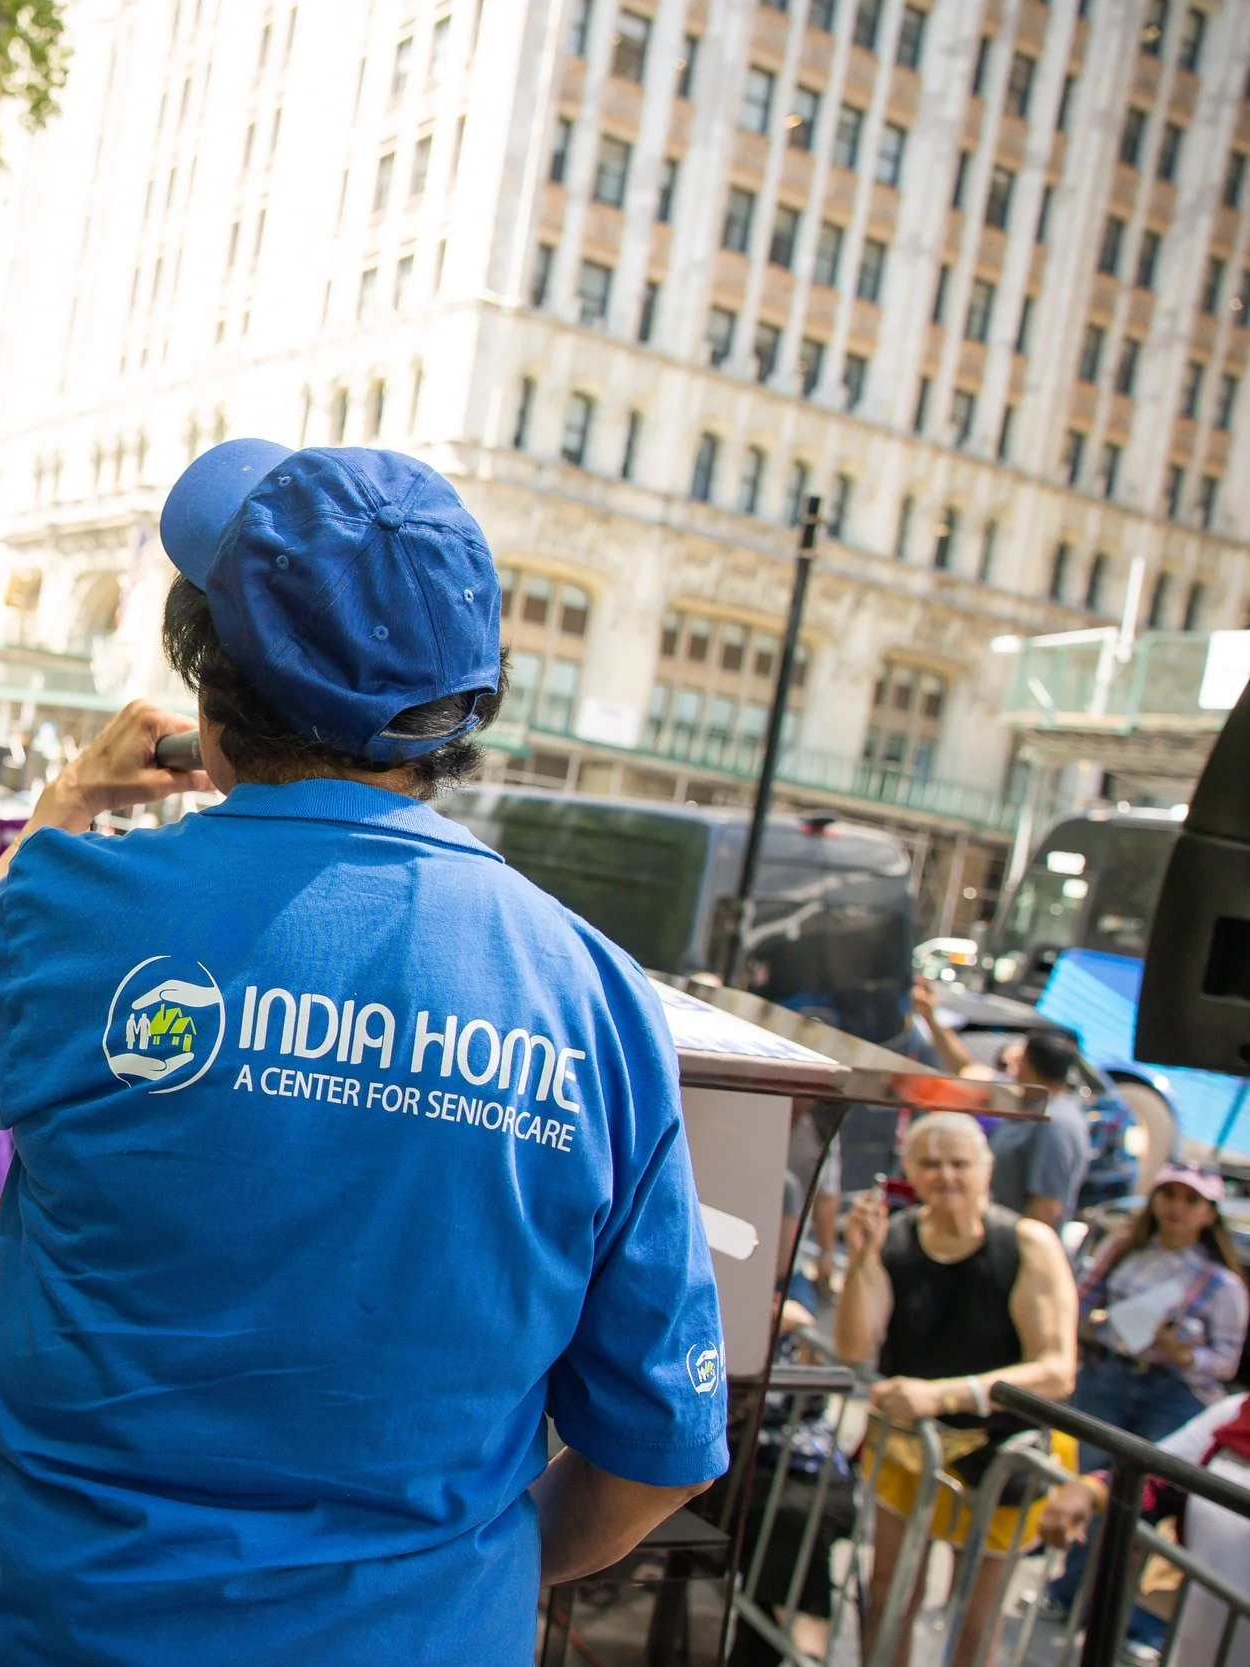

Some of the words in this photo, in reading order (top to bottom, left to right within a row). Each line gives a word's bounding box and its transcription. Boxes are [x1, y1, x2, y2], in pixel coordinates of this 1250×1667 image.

[239, 985, 396, 1068] INDIA
[410, 1010, 585, 1114] HOME
[233, 1064, 253, 1092] A
[260, 1067, 361, 1107] CENTER
[366, 1082, 419, 1115] FOR
[425, 1090, 576, 1152] SENIORCARE
